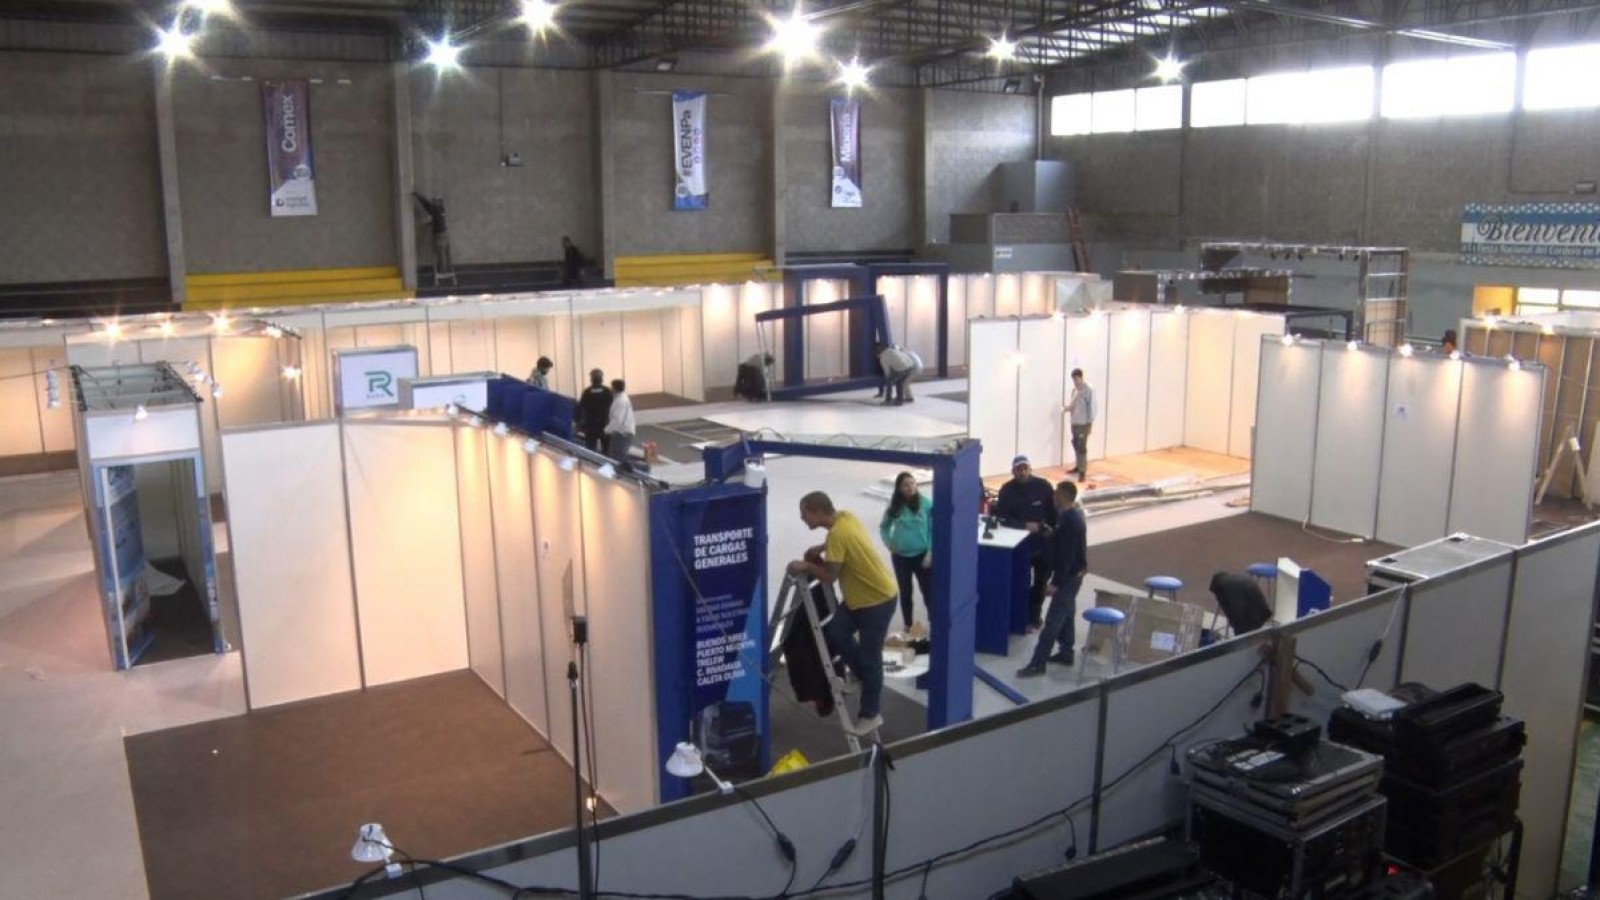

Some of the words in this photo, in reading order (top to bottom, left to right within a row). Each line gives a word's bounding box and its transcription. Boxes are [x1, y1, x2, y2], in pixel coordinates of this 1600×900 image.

[282, 95, 297, 152] Comex
[681, 110, 693, 177] #EVENPa
[693, 527, 753, 546] TRANSPORTE
[694, 547, 708, 558] DE
[709, 540, 747, 555] CARGAS
[694, 551, 748, 570] GENERALES
[697, 636, 726, 649] BUENOS
